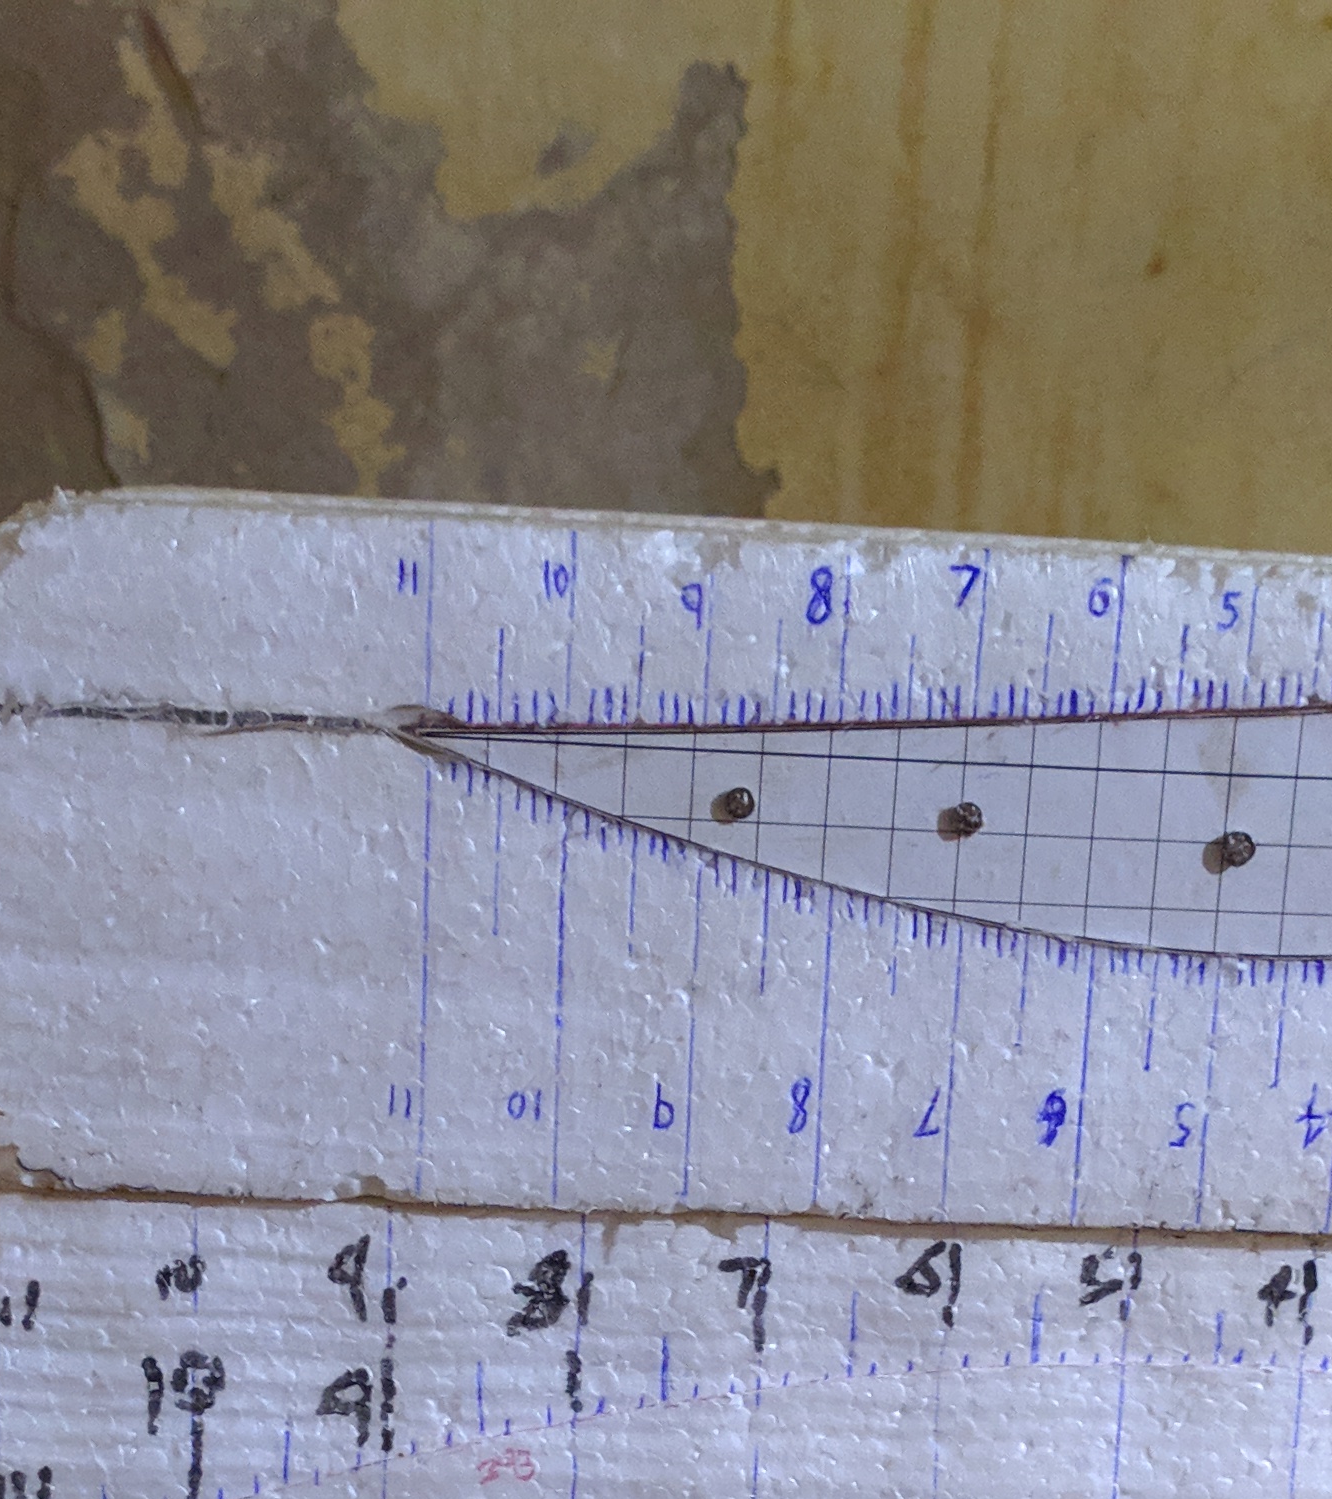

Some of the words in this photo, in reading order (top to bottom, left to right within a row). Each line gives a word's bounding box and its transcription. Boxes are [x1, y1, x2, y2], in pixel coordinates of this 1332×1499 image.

[398, 558, 418, 595] 11
[543, 558, 569, 598] 10
[681, 583, 704, 630] 9
[805, 566, 834, 626] 8
[950, 563, 980, 608] 7
[1087, 578, 1115, 617] 6
[1216, 590, 1242, 632] 5
[507, 1088, 541, 1121] 10
[787, 1077, 813, 1135] 8
[911, 1087, 942, 1138] 7
[1168, 1102, 1196, 1148] 5
